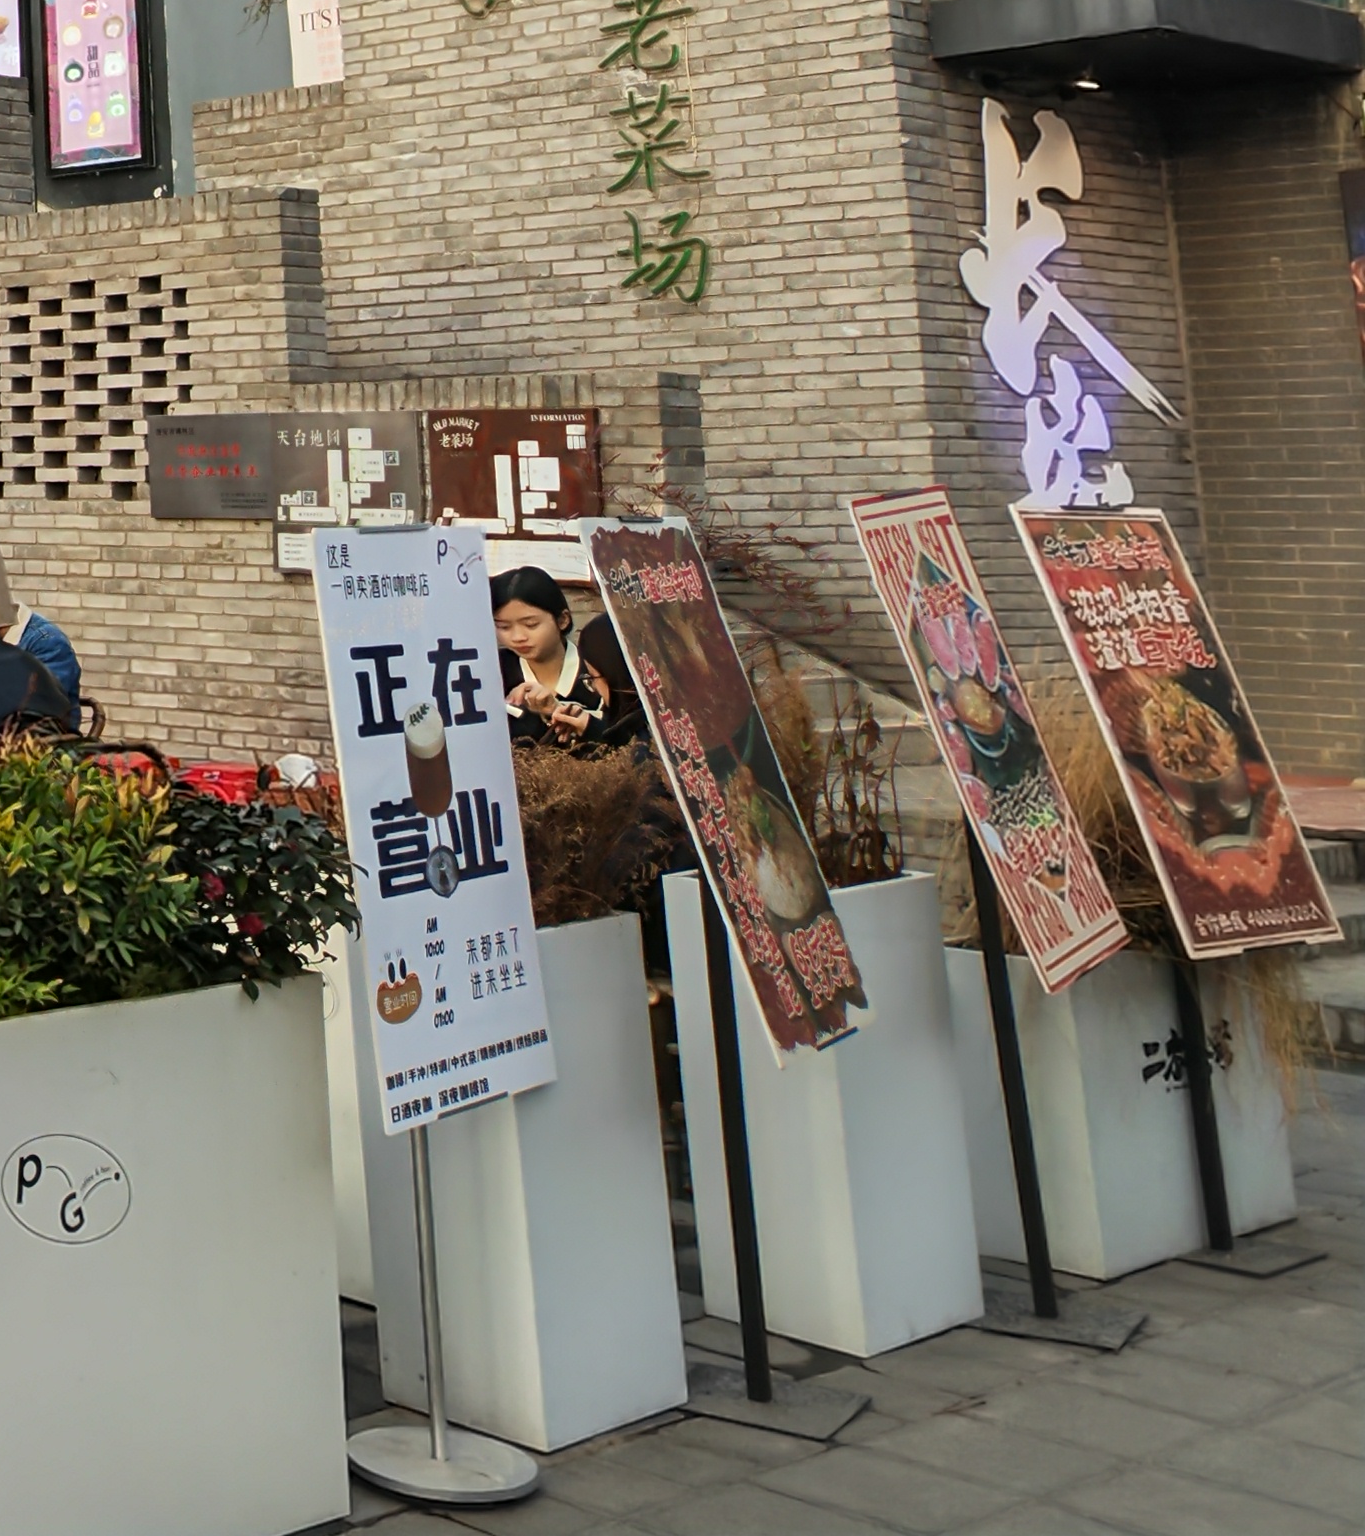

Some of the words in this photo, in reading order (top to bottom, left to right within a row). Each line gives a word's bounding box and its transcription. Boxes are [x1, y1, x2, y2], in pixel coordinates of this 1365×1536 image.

[432, 418, 448, 432] OLD
[448, 416, 480, 431] MARKET
[530, 413, 587, 423] INFORMATION
[438, 432, 475, 449] 老菜场
[326, 543, 351, 570] 这是
[436, 538, 448, 564] P
[456, 562, 469, 585] G
[330, 572, 430, 601] 一间卖酒的咖啡店
[350, 637, 488, 738] 正在
[370, 787, 510, 899] 营业
[426, 916, 439, 934] AM
[424, 939, 445, 958] 10:00
[465, 926, 521, 965] 来都来了
[469, 959, 528, 1001] 进来坐坐
[434, 985, 447, 1004] AM
[16, 1153, 43, 1205] P
[59, 1190, 85, 1234] G
